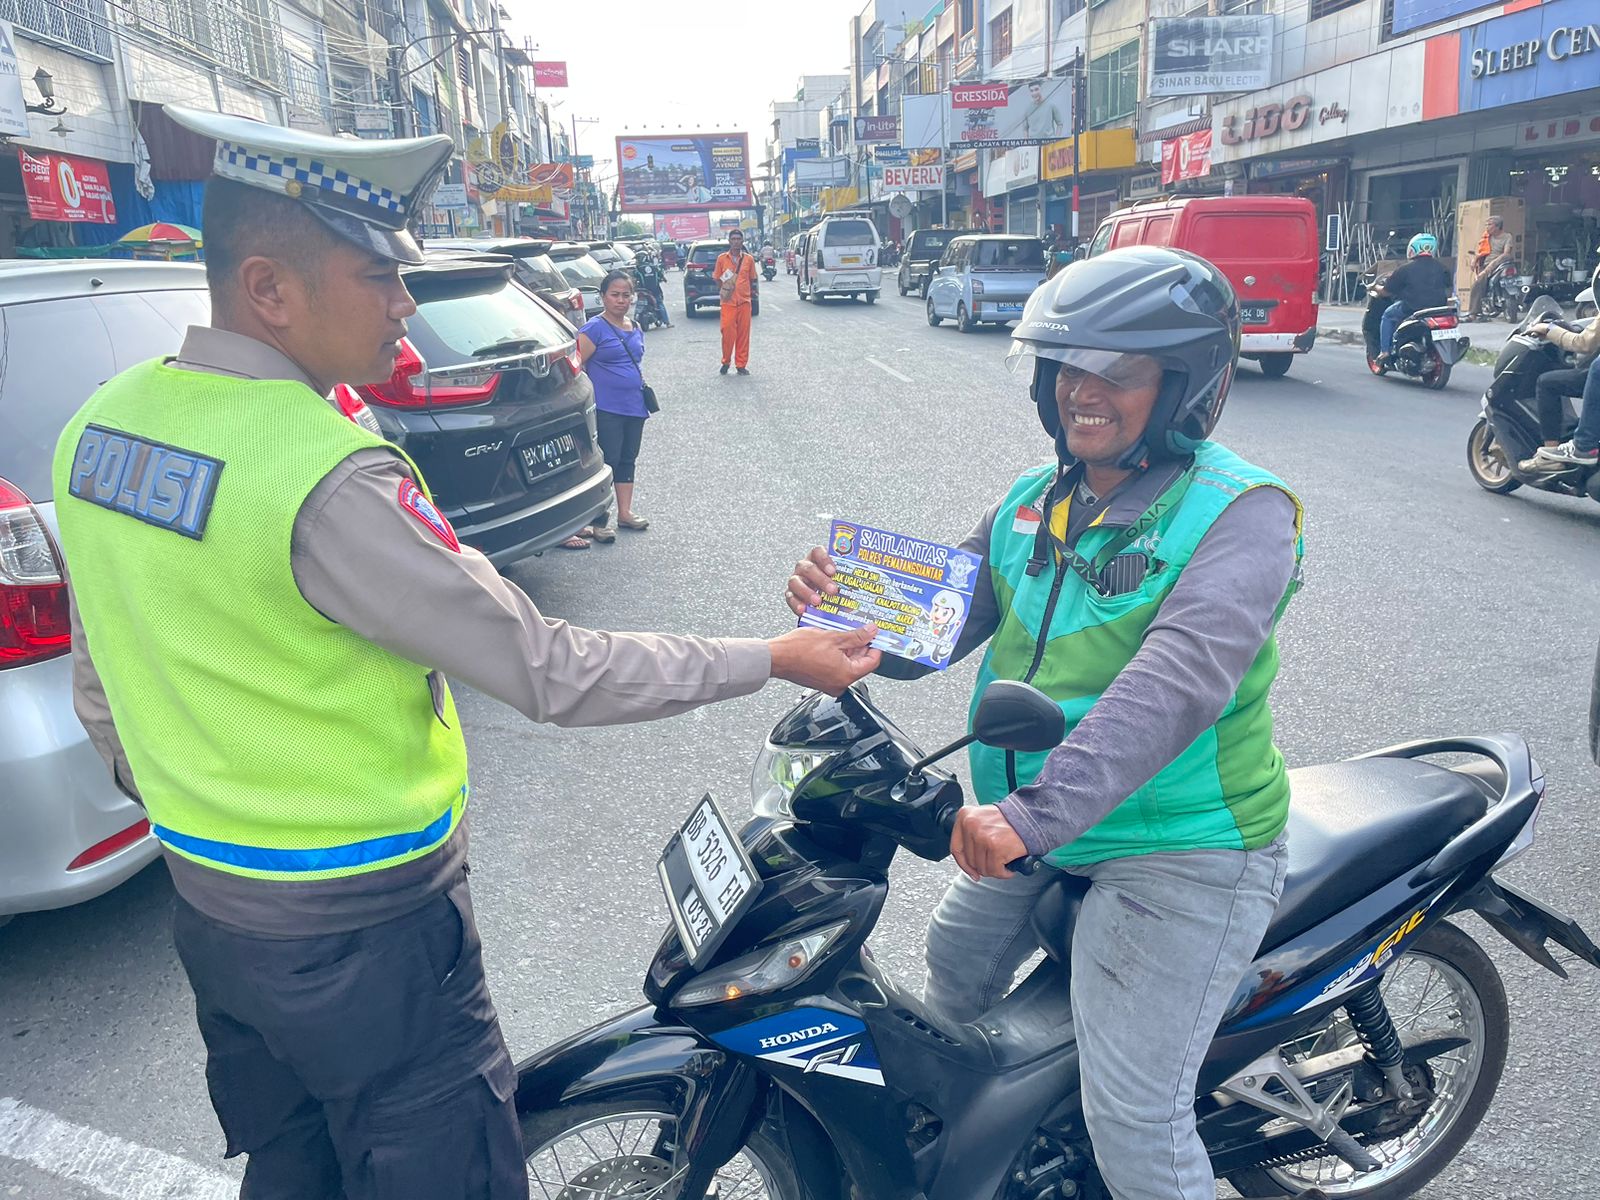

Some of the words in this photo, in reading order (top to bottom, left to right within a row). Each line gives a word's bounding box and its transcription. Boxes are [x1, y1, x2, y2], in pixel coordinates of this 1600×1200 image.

[1471, 39, 1542, 79] SLEEP
[1158, 76, 1191, 88] SINAR
[1194, 73, 1224, 86] BARU
[954, 90, 1006, 102] CRESSIDA
[867, 120, 895, 132] in-lite
[973, 140, 1000, 148] CAHAYA
[1020, 151, 1029, 171] LG
[884, 166, 944, 186] BEVERLY
[1028, 321, 1070, 332] HONDA
[464, 440, 503, 458] CR-V
[71, 428, 217, 532] POLISI
[858, 548, 883, 565] POLRES
[860, 528, 948, 568] SATLANTAS
[845, 574, 885, 595] UGAL-UGALAN
[853, 567, 869, 579] HELM
[868, 571, 880, 582] SNI
[839, 597, 860, 611] RAMBU
[895, 613, 915, 626] MARKA
[875, 595, 900, 610] KNALPOT
[899, 603, 922, 616] RACING
[686, 808, 708, 842] BB
[698, 829, 728, 882] 5326
[717, 874, 745, 916] EH
[759, 1021, 839, 1049] HONDA
